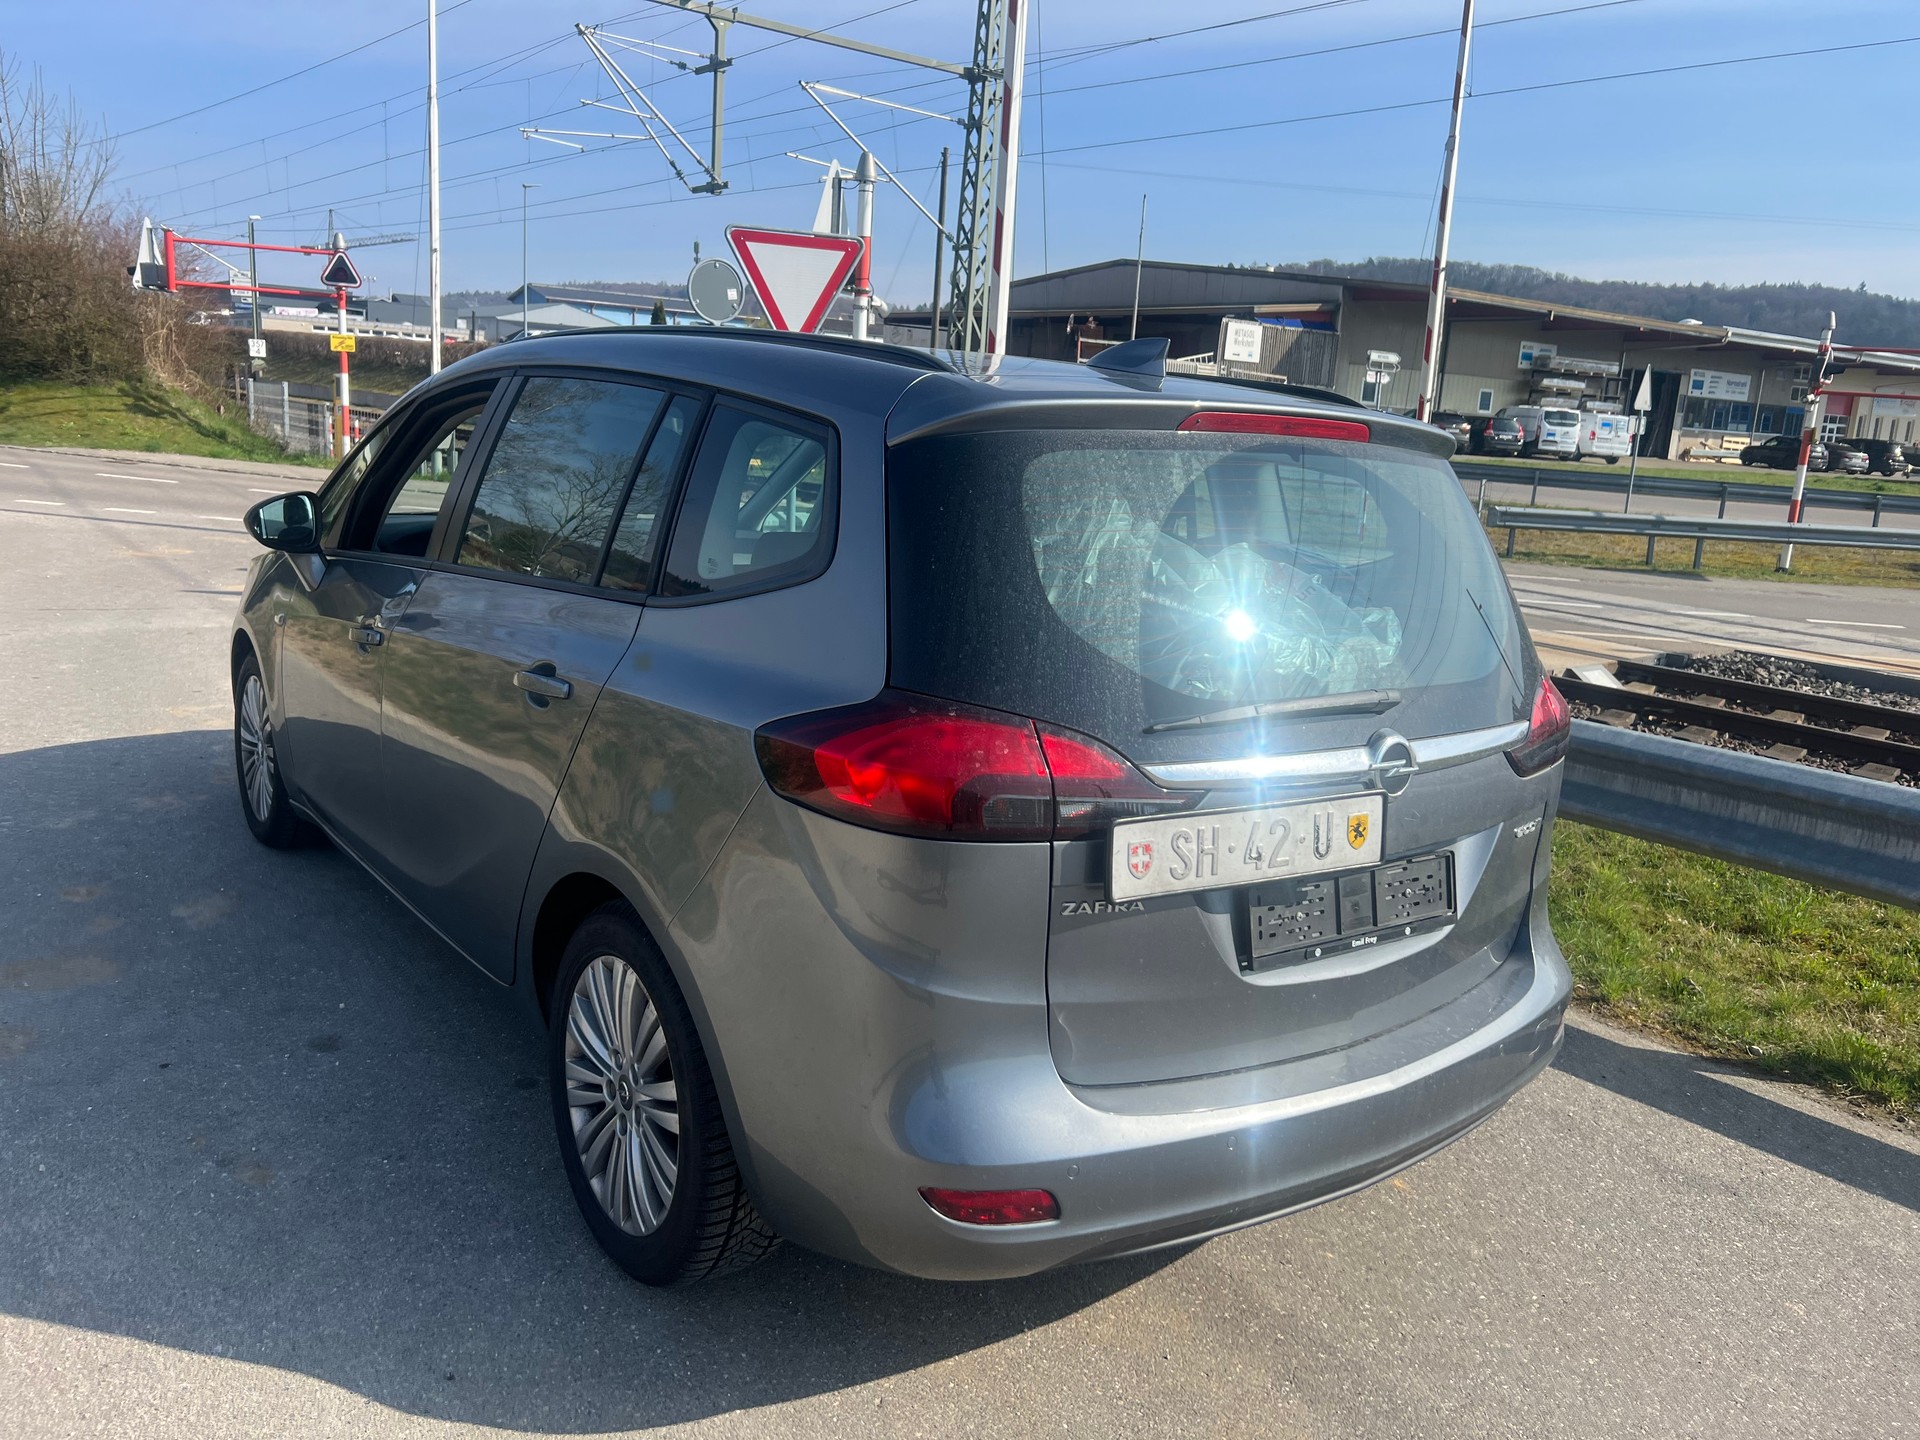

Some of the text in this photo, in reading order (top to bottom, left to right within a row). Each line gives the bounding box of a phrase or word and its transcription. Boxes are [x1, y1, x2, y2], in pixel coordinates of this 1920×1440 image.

[251, 340, 265, 348] 357
[1061, 901, 1145, 916] ZAFIRA
[1352, 936, 1377, 947] Emil Frey
